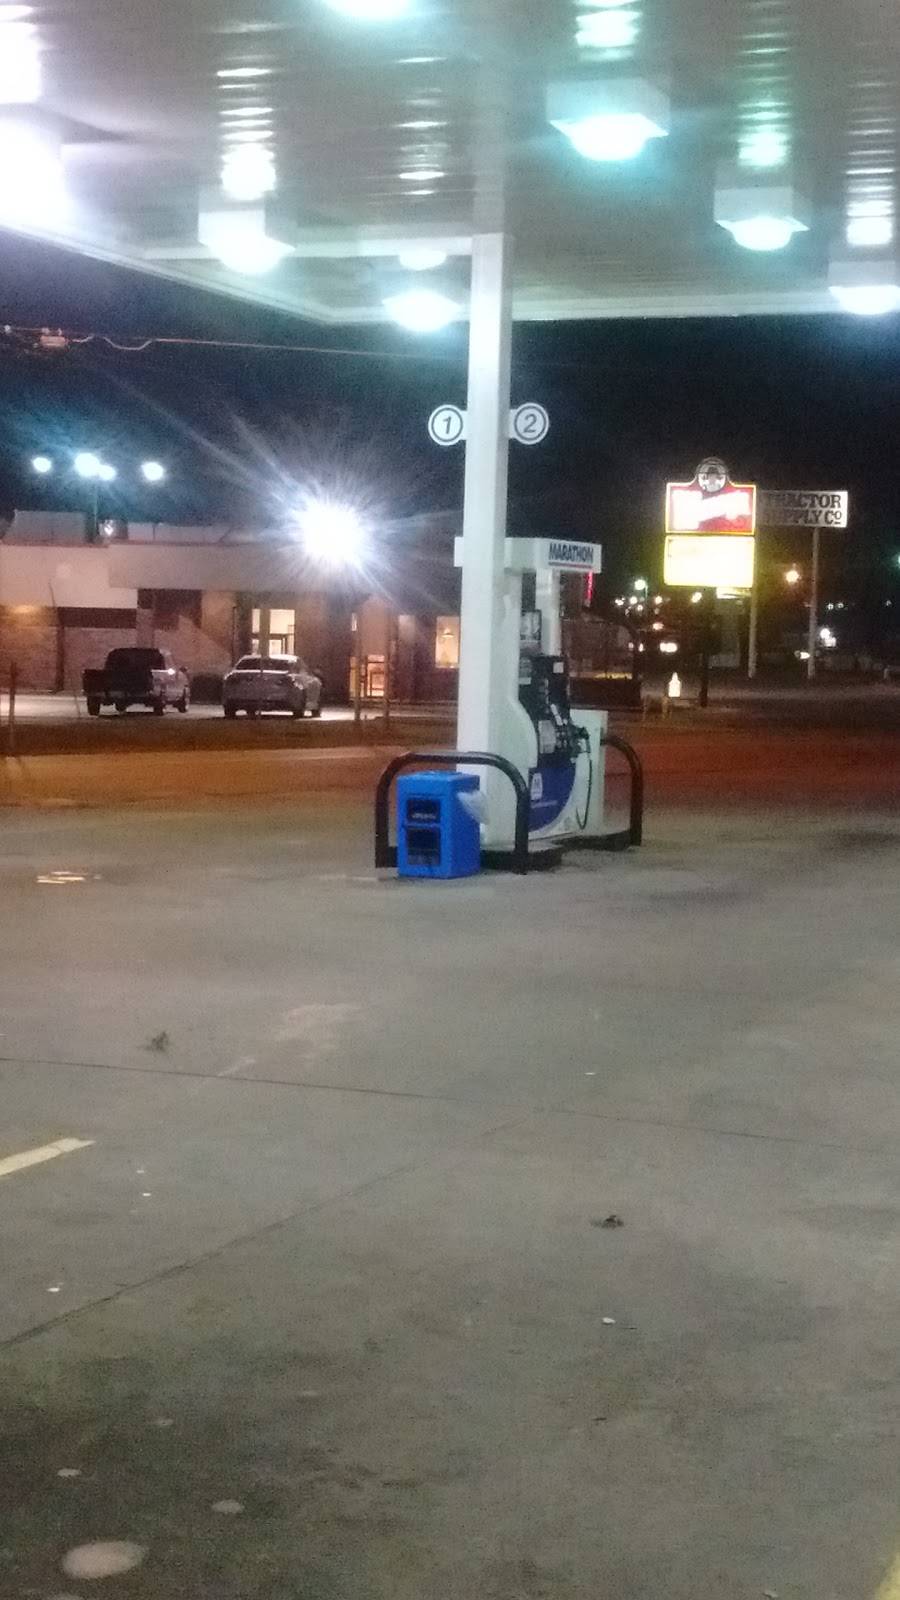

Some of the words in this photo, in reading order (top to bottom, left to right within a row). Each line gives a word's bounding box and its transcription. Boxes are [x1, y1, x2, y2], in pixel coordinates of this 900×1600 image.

[443, 415, 452, 435] 1
[523, 413, 537, 433] 2
[548, 542, 593, 563] MARATHON
